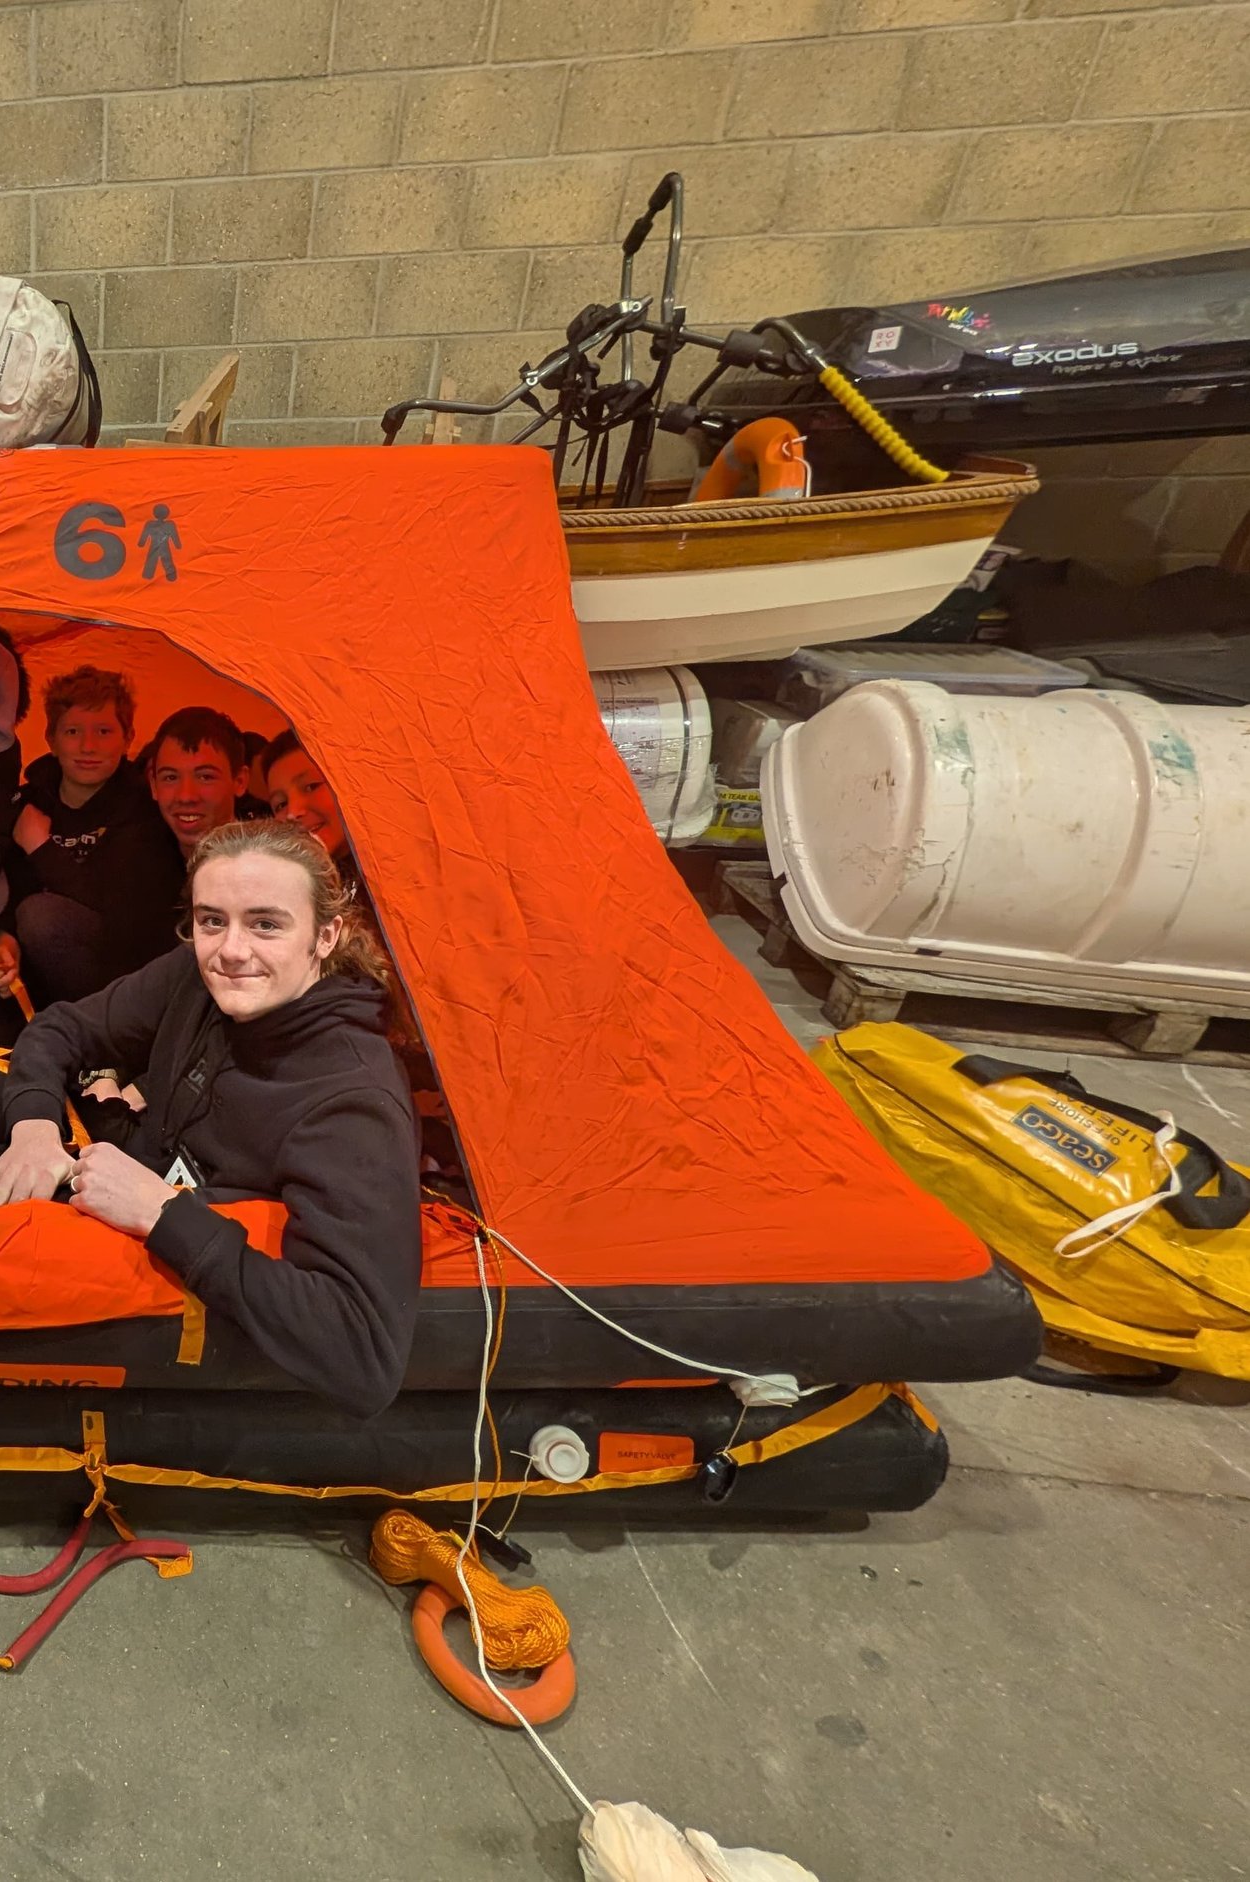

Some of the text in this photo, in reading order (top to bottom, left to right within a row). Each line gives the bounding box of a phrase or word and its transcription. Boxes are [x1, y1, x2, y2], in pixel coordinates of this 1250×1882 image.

[54, 502, 127, 581] 6
[1049, 1098, 1121, 1146] OFFSHORE
[617, 1450, 649, 1459] SAFETY
